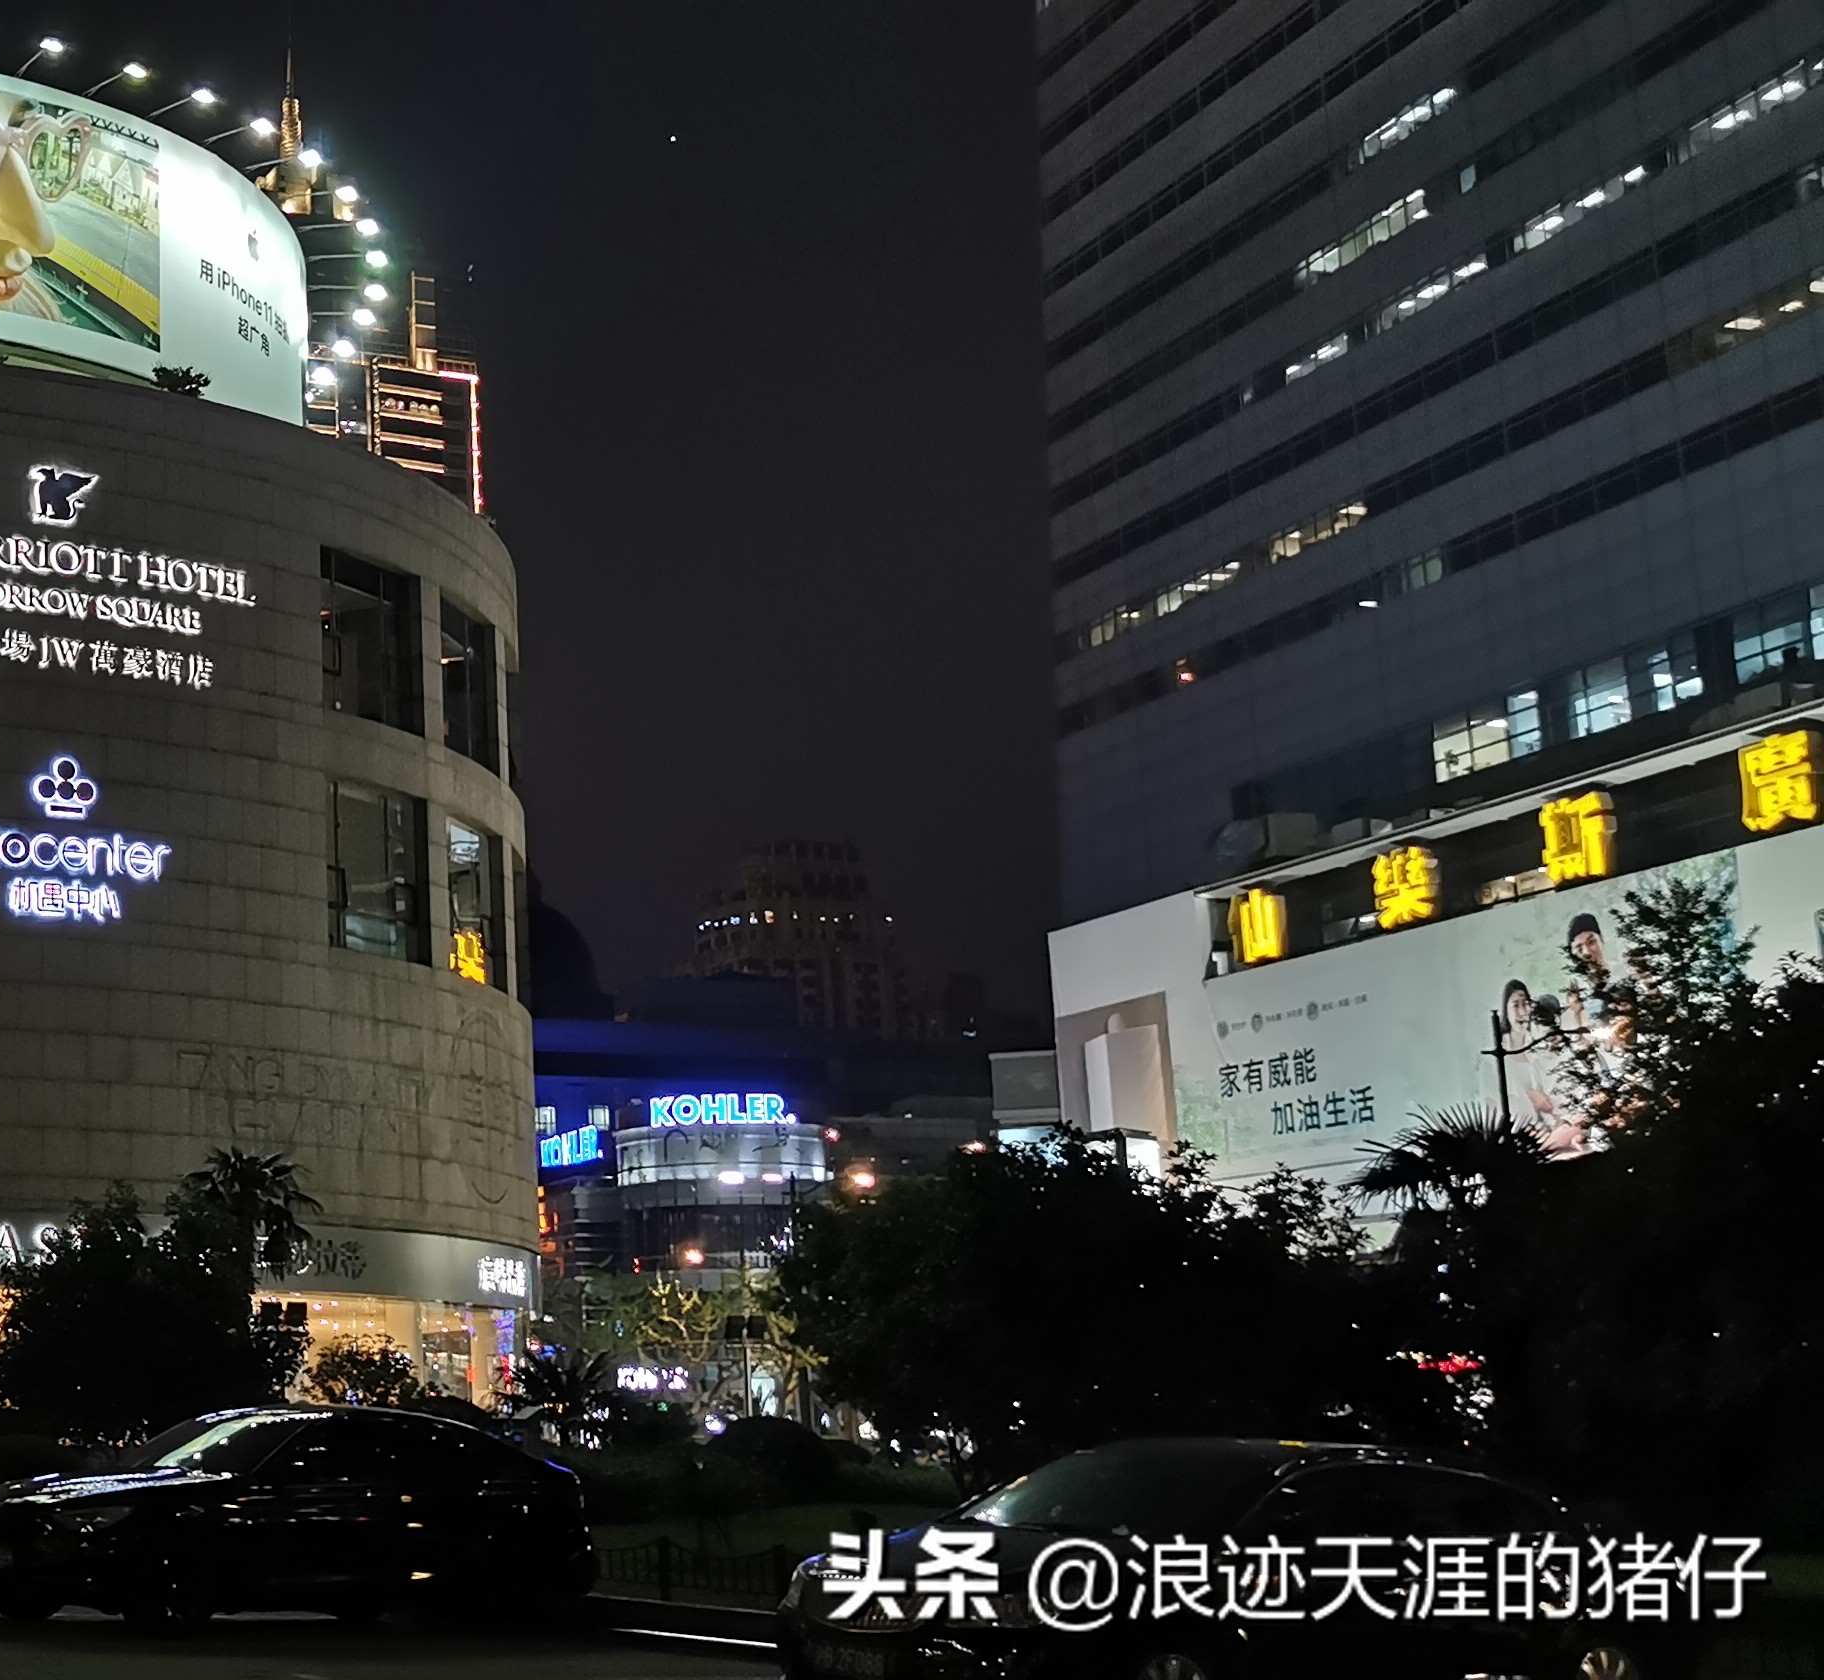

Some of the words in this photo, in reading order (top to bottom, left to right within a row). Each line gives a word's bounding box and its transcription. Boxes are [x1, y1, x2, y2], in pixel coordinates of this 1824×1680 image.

[199, 259, 214, 285] 用
[217, 267, 263, 316] iPhone
[263, 301, 274, 327] 11
[237, 316, 270, 357] 超广角
[136, 549, 256, 608] HOTEL
[94, 594, 204, 636] SQUARE
[7, 876, 122, 925] 机遇中心
[1218, 1047, 1318, 1099] 家有威能
[1270, 1085, 1376, 1136] 加油生活
